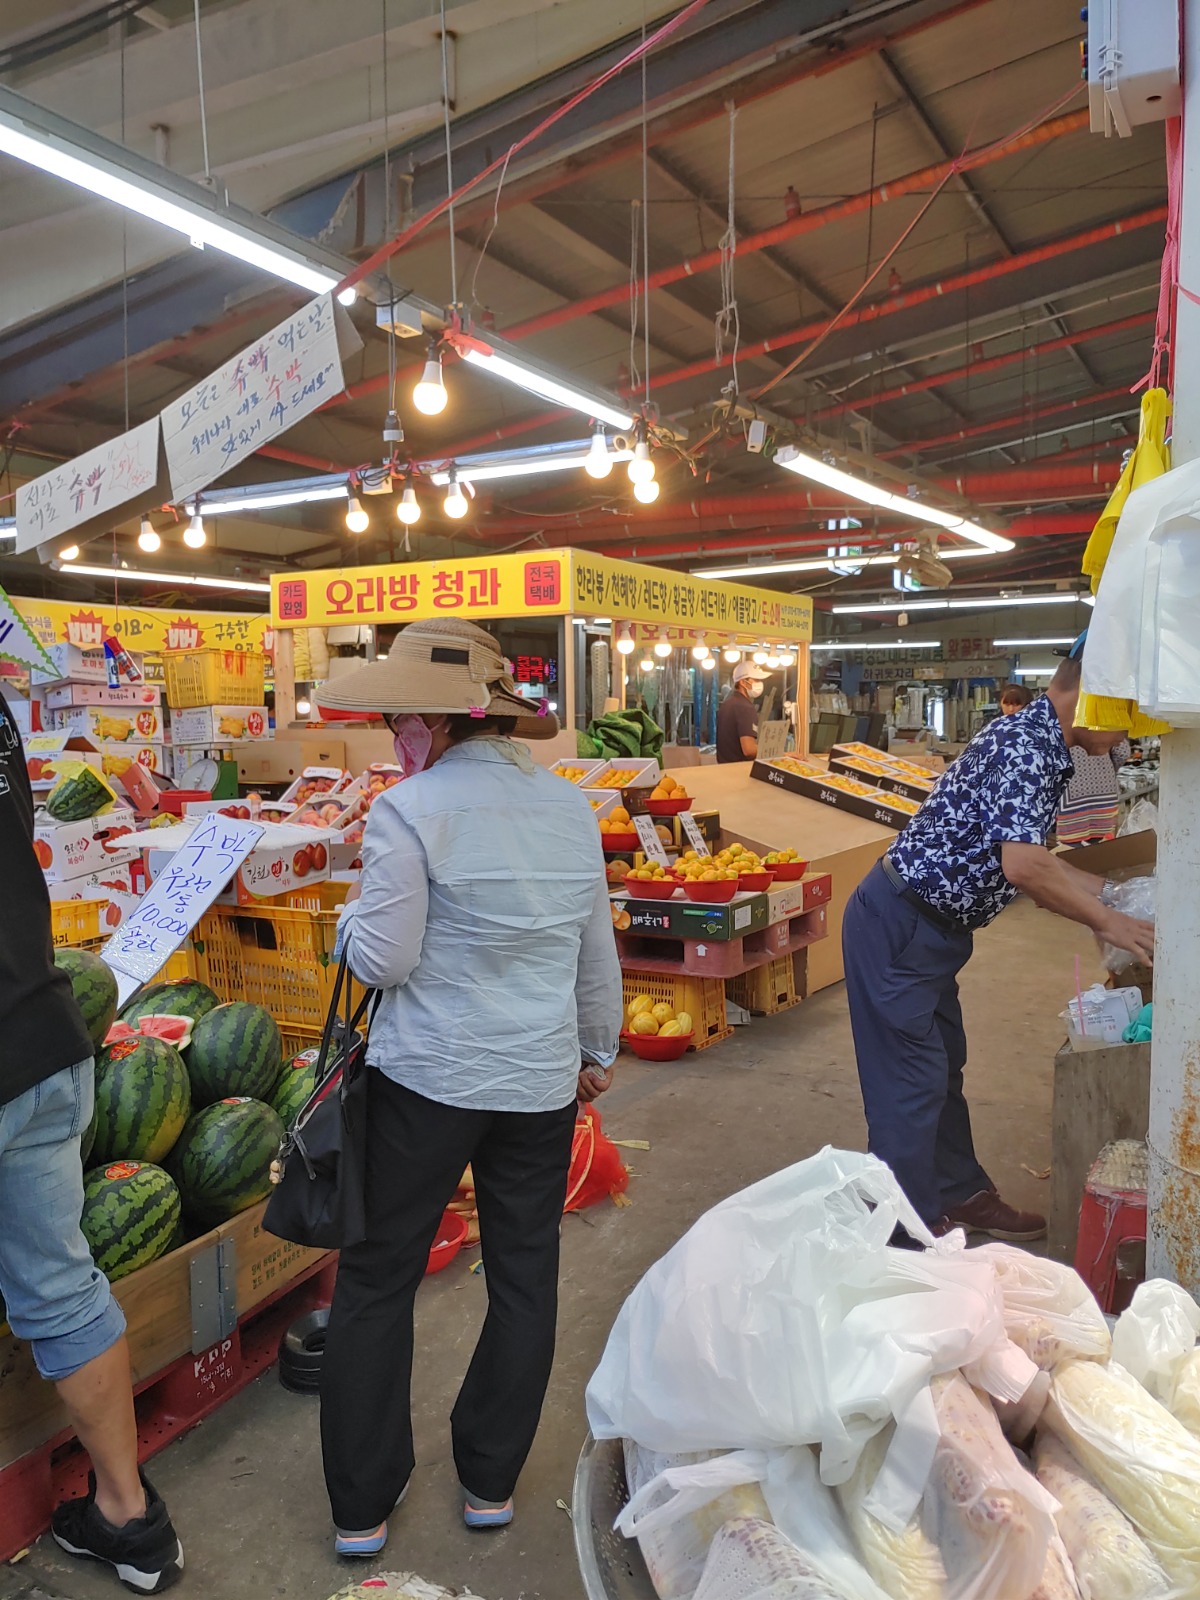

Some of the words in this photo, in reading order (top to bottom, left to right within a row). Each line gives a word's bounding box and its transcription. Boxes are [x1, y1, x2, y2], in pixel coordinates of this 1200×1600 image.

[529, 565, 555, 583] 전국
[283, 584, 303, 598] 카드
[325, 574, 420, 615] 오라방
[432, 568, 501, 608] 청과
[529, 584, 555, 602] 택배
[283, 601, 303, 616] 환영
[67, 855, 85, 865] 복숭아
